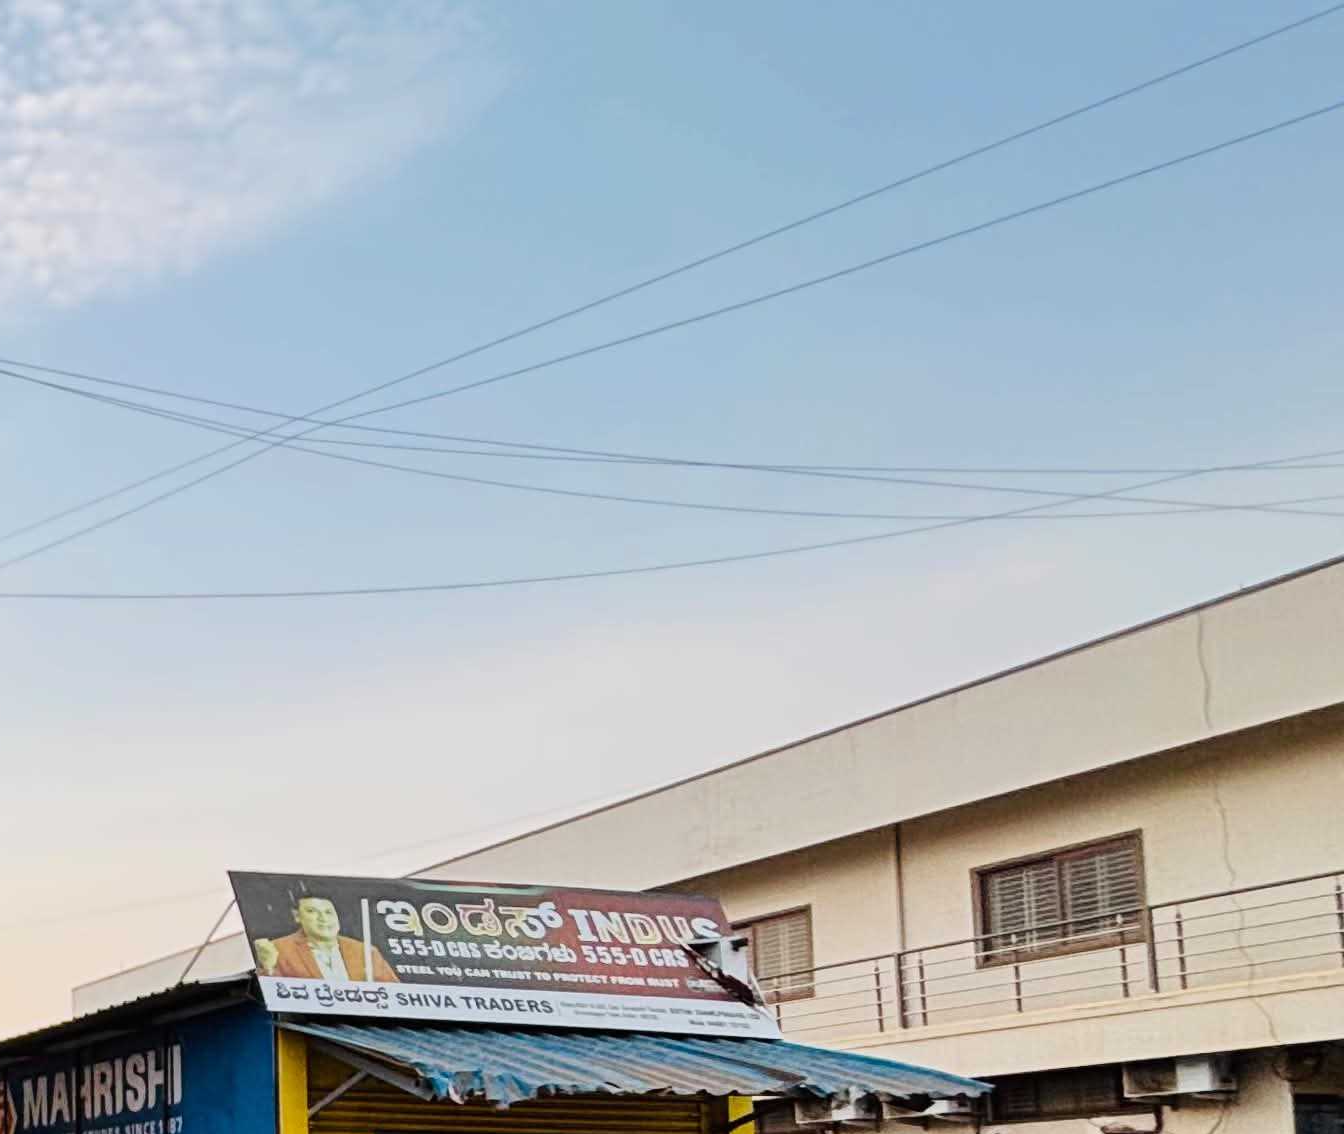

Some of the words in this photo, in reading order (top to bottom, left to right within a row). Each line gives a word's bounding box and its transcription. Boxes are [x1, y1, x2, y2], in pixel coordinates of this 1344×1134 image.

[446, 941, 481, 959] CRS
[651, 949, 689, 968] CRS
[395, 965, 435, 975] STEEL
[436, 967, 462, 976] YOU
[464, 968, 491, 978] CAN
[492, 969, 531, 980] TRUST
[535, 972, 551, 981] TO
[554, 973, 610, 985] PROTECT
[611, 976, 649, 986] FROM
[650, 978, 680, 988] RUST
[275, 982, 309, 1000] ಶಿವ
[396, 992, 456, 1009] SHIVA
[462, 996, 553, 1014] TRADERS
